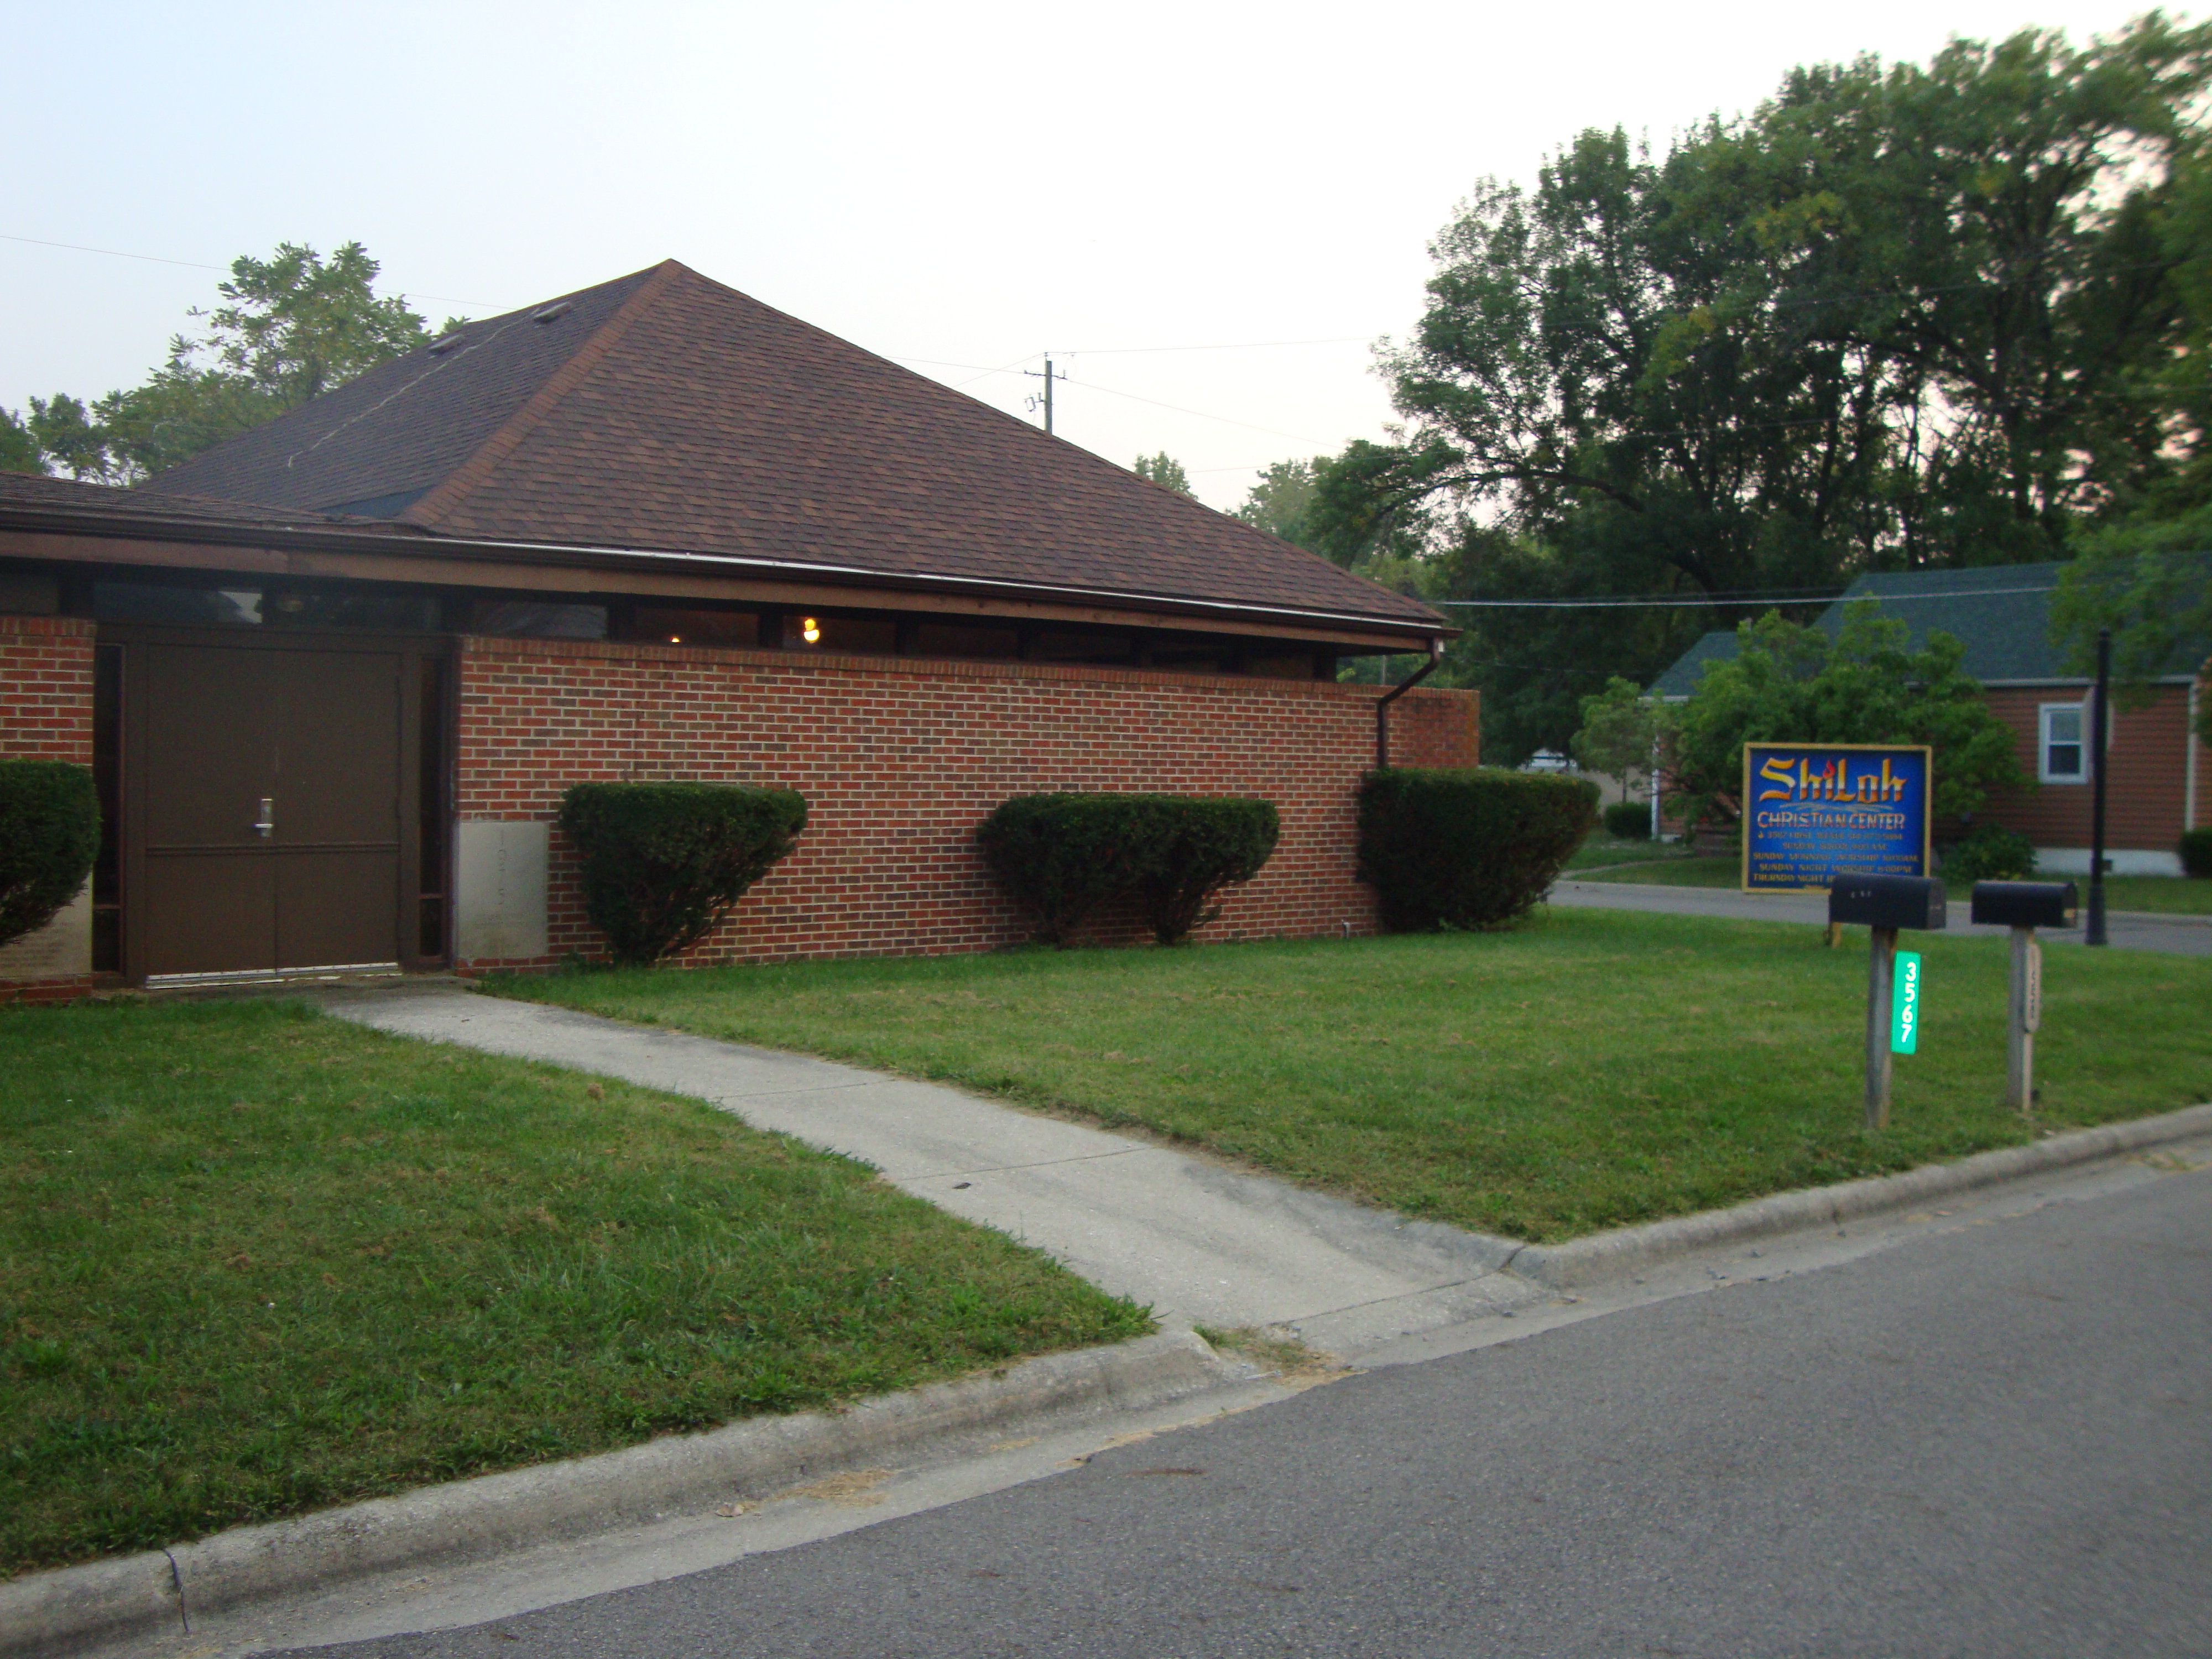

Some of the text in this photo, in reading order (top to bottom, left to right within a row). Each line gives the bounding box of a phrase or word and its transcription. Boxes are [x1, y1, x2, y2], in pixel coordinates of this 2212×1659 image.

[1757, 811, 1905, 830] CHRISTIAN CENTER
[1759, 863, 1794, 872] SUNDAY
[1901, 961, 1917, 1043] 3567
